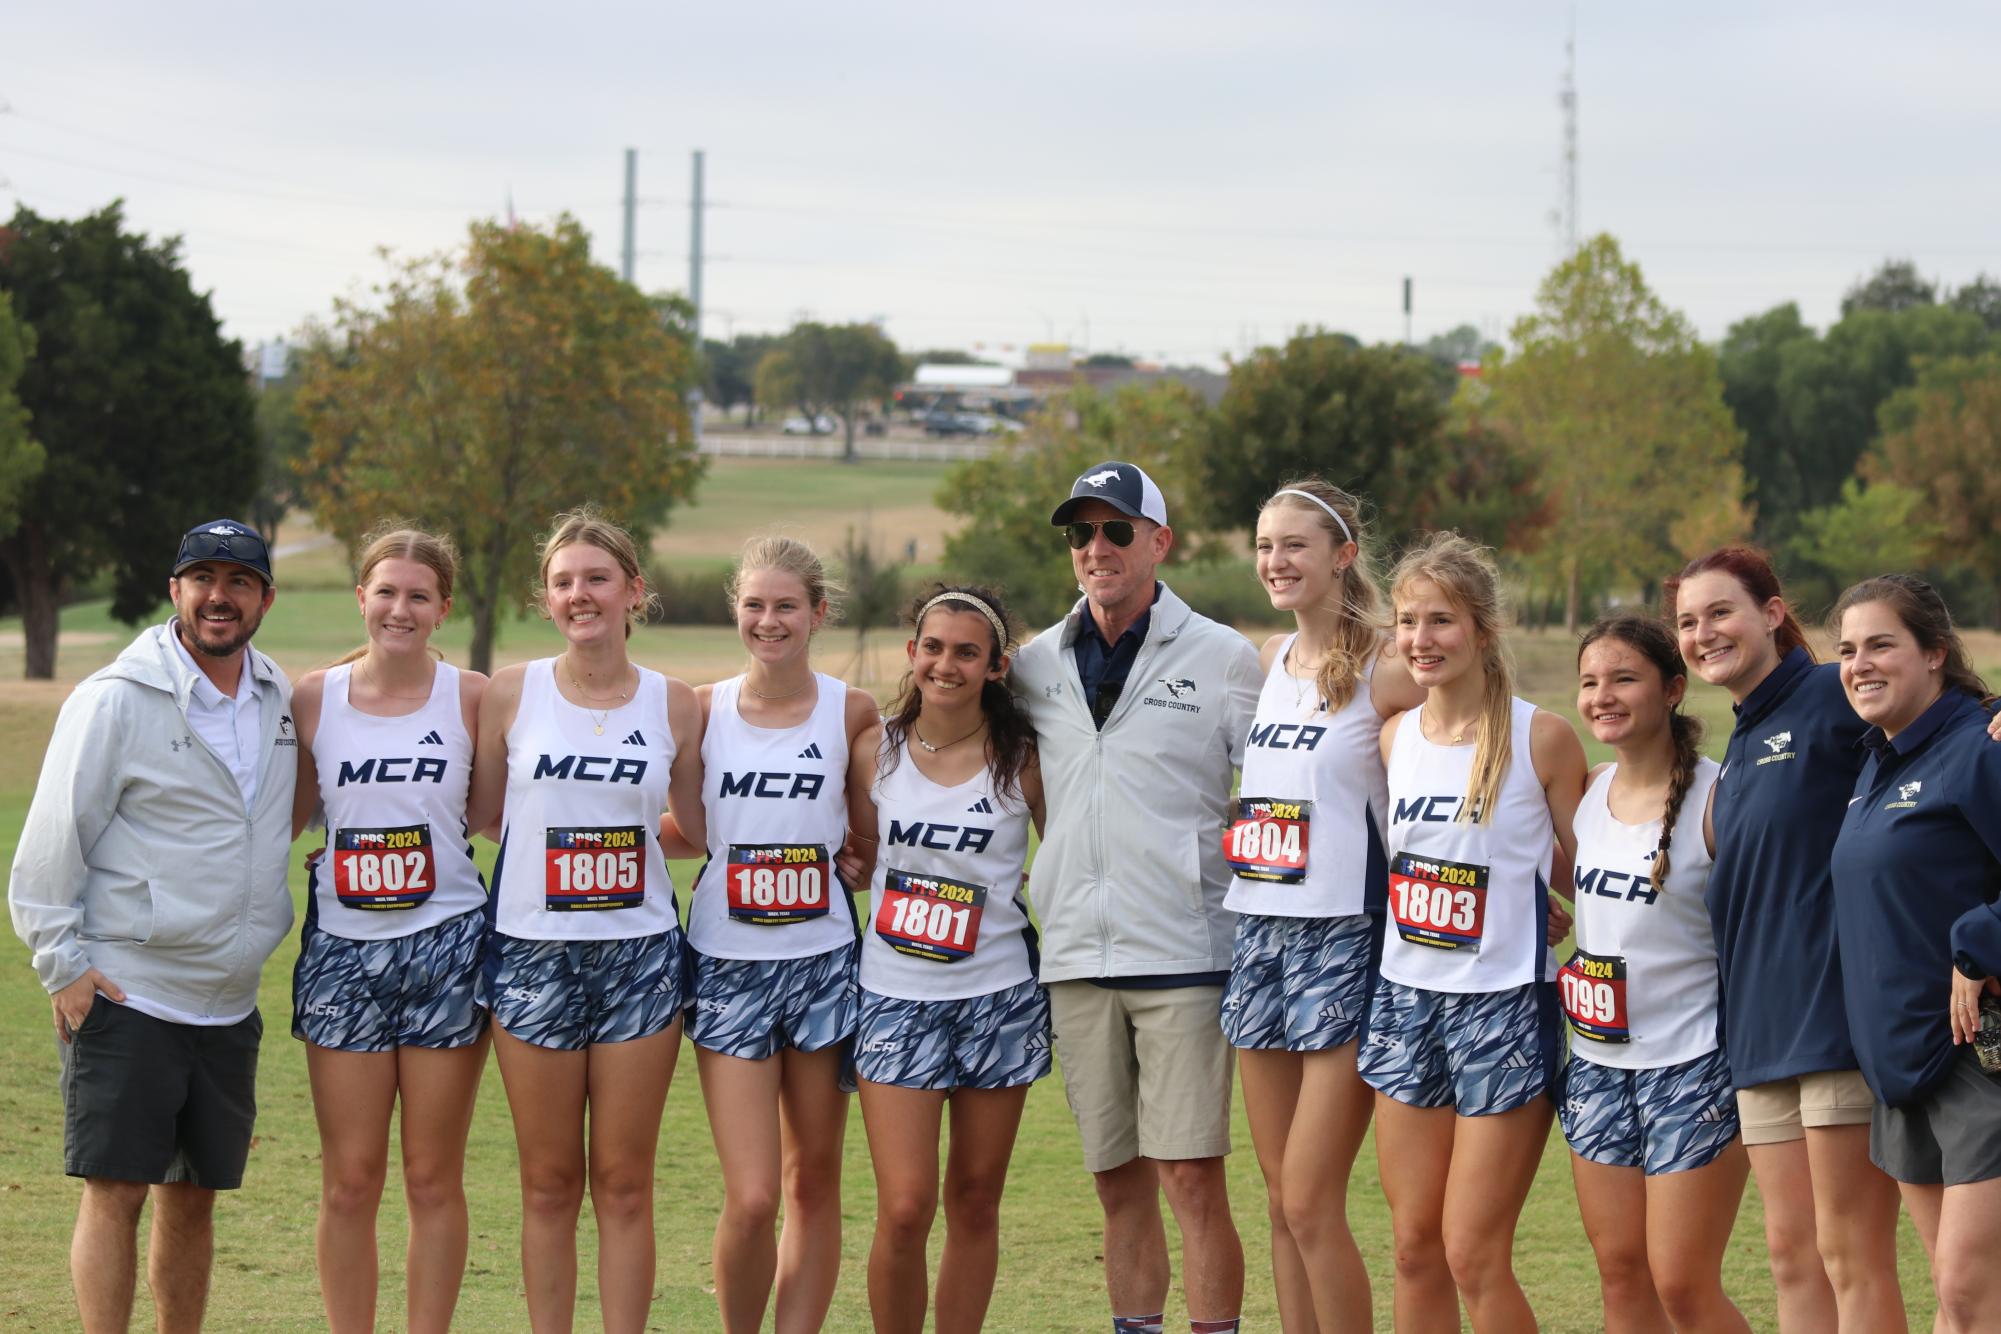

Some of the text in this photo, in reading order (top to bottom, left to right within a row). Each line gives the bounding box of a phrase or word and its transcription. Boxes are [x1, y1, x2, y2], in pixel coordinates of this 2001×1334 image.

[1143, 697, 1201, 714] CROSS COUNTRY
[1246, 723, 1328, 751] MCA
[337, 757, 448, 788] MCA
[534, 754, 648, 785] MCA
[720, 771, 826, 800] MCA
[346, 830, 422, 850] TAPPS 2024
[558, 831, 636, 849] TAPPS 2024
[888, 819, 995, 854] MCA
[1232, 821, 1302, 864] 1804
[740, 847, 818, 864] TAPPS 2024
[342, 850, 428, 892] 1802
[553, 851, 639, 892] 1805
[1400, 858, 1476, 887] TAPPS 2024
[1574, 865, 1666, 906] MCA
[735, 866, 822, 907] 1800
[897, 875, 974, 904] TAPPS 2024
[1395, 880, 1477, 932] 1803
[890, 897, 971, 946] 1801
[1583, 959, 1614, 979] 2024
[303, 1003, 340, 1018] MCA
[1560, 972, 1616, 1023] 1799
[860, 1041, 897, 1056] MCA
